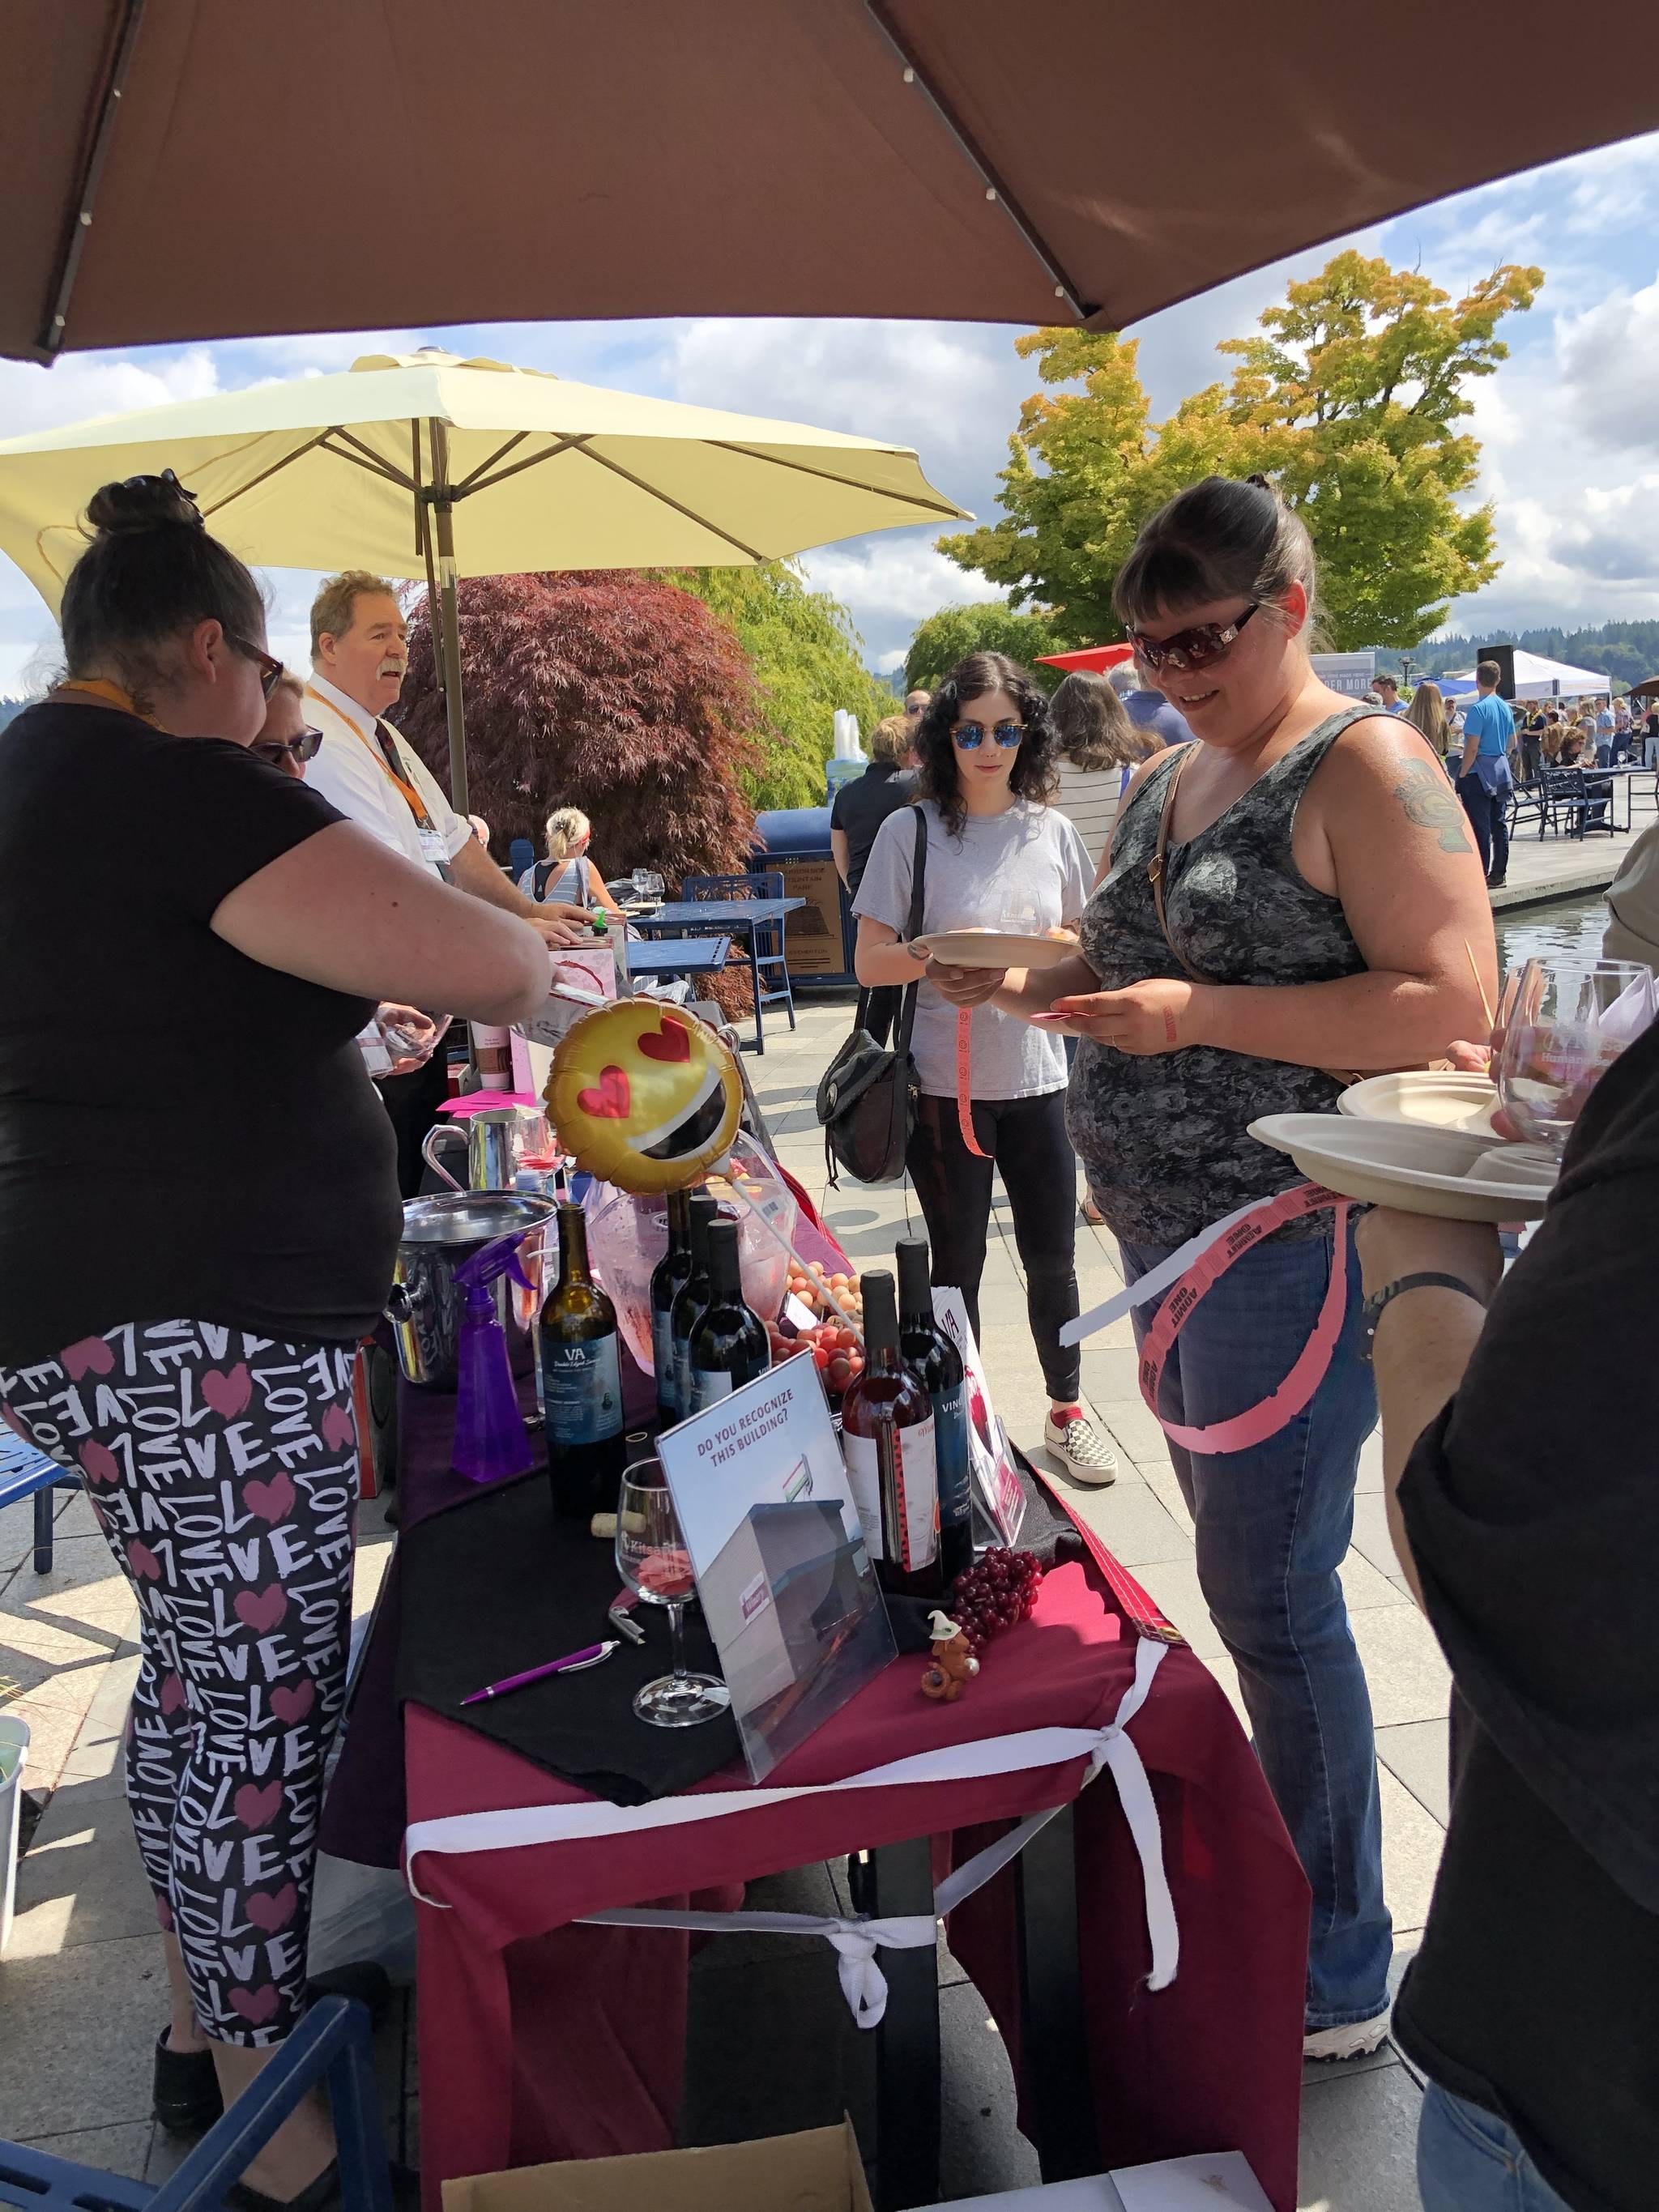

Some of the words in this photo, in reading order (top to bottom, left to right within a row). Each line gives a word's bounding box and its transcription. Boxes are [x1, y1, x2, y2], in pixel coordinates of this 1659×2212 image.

[1346, 677, 1371, 690] MORE
[1168, 1286, 1188, 1314] ONE
[1171, 1287, 1198, 1328] ADMIT
[565, 1348, 586, 1362] VA
[116, 1383, 192, 1491] LOVE
[251, 1365, 323, 1468] LOVE
[697, 1438, 713, 1456] DO
[714, 1423, 737, 1444] YOU
[739, 1388, 794, 1430] RECOGNIZE
[710, 1443, 736, 1468] THIS
[736, 1408, 789, 1451] BUILDING?
[159, 1494, 234, 1592] LOVE
[293, 1466, 352, 1570] LOVE
[163, 1593, 225, 1682] LOVE
[287, 1577, 341, 1675] LOVE
[176, 1877, 228, 1978] LOVE
